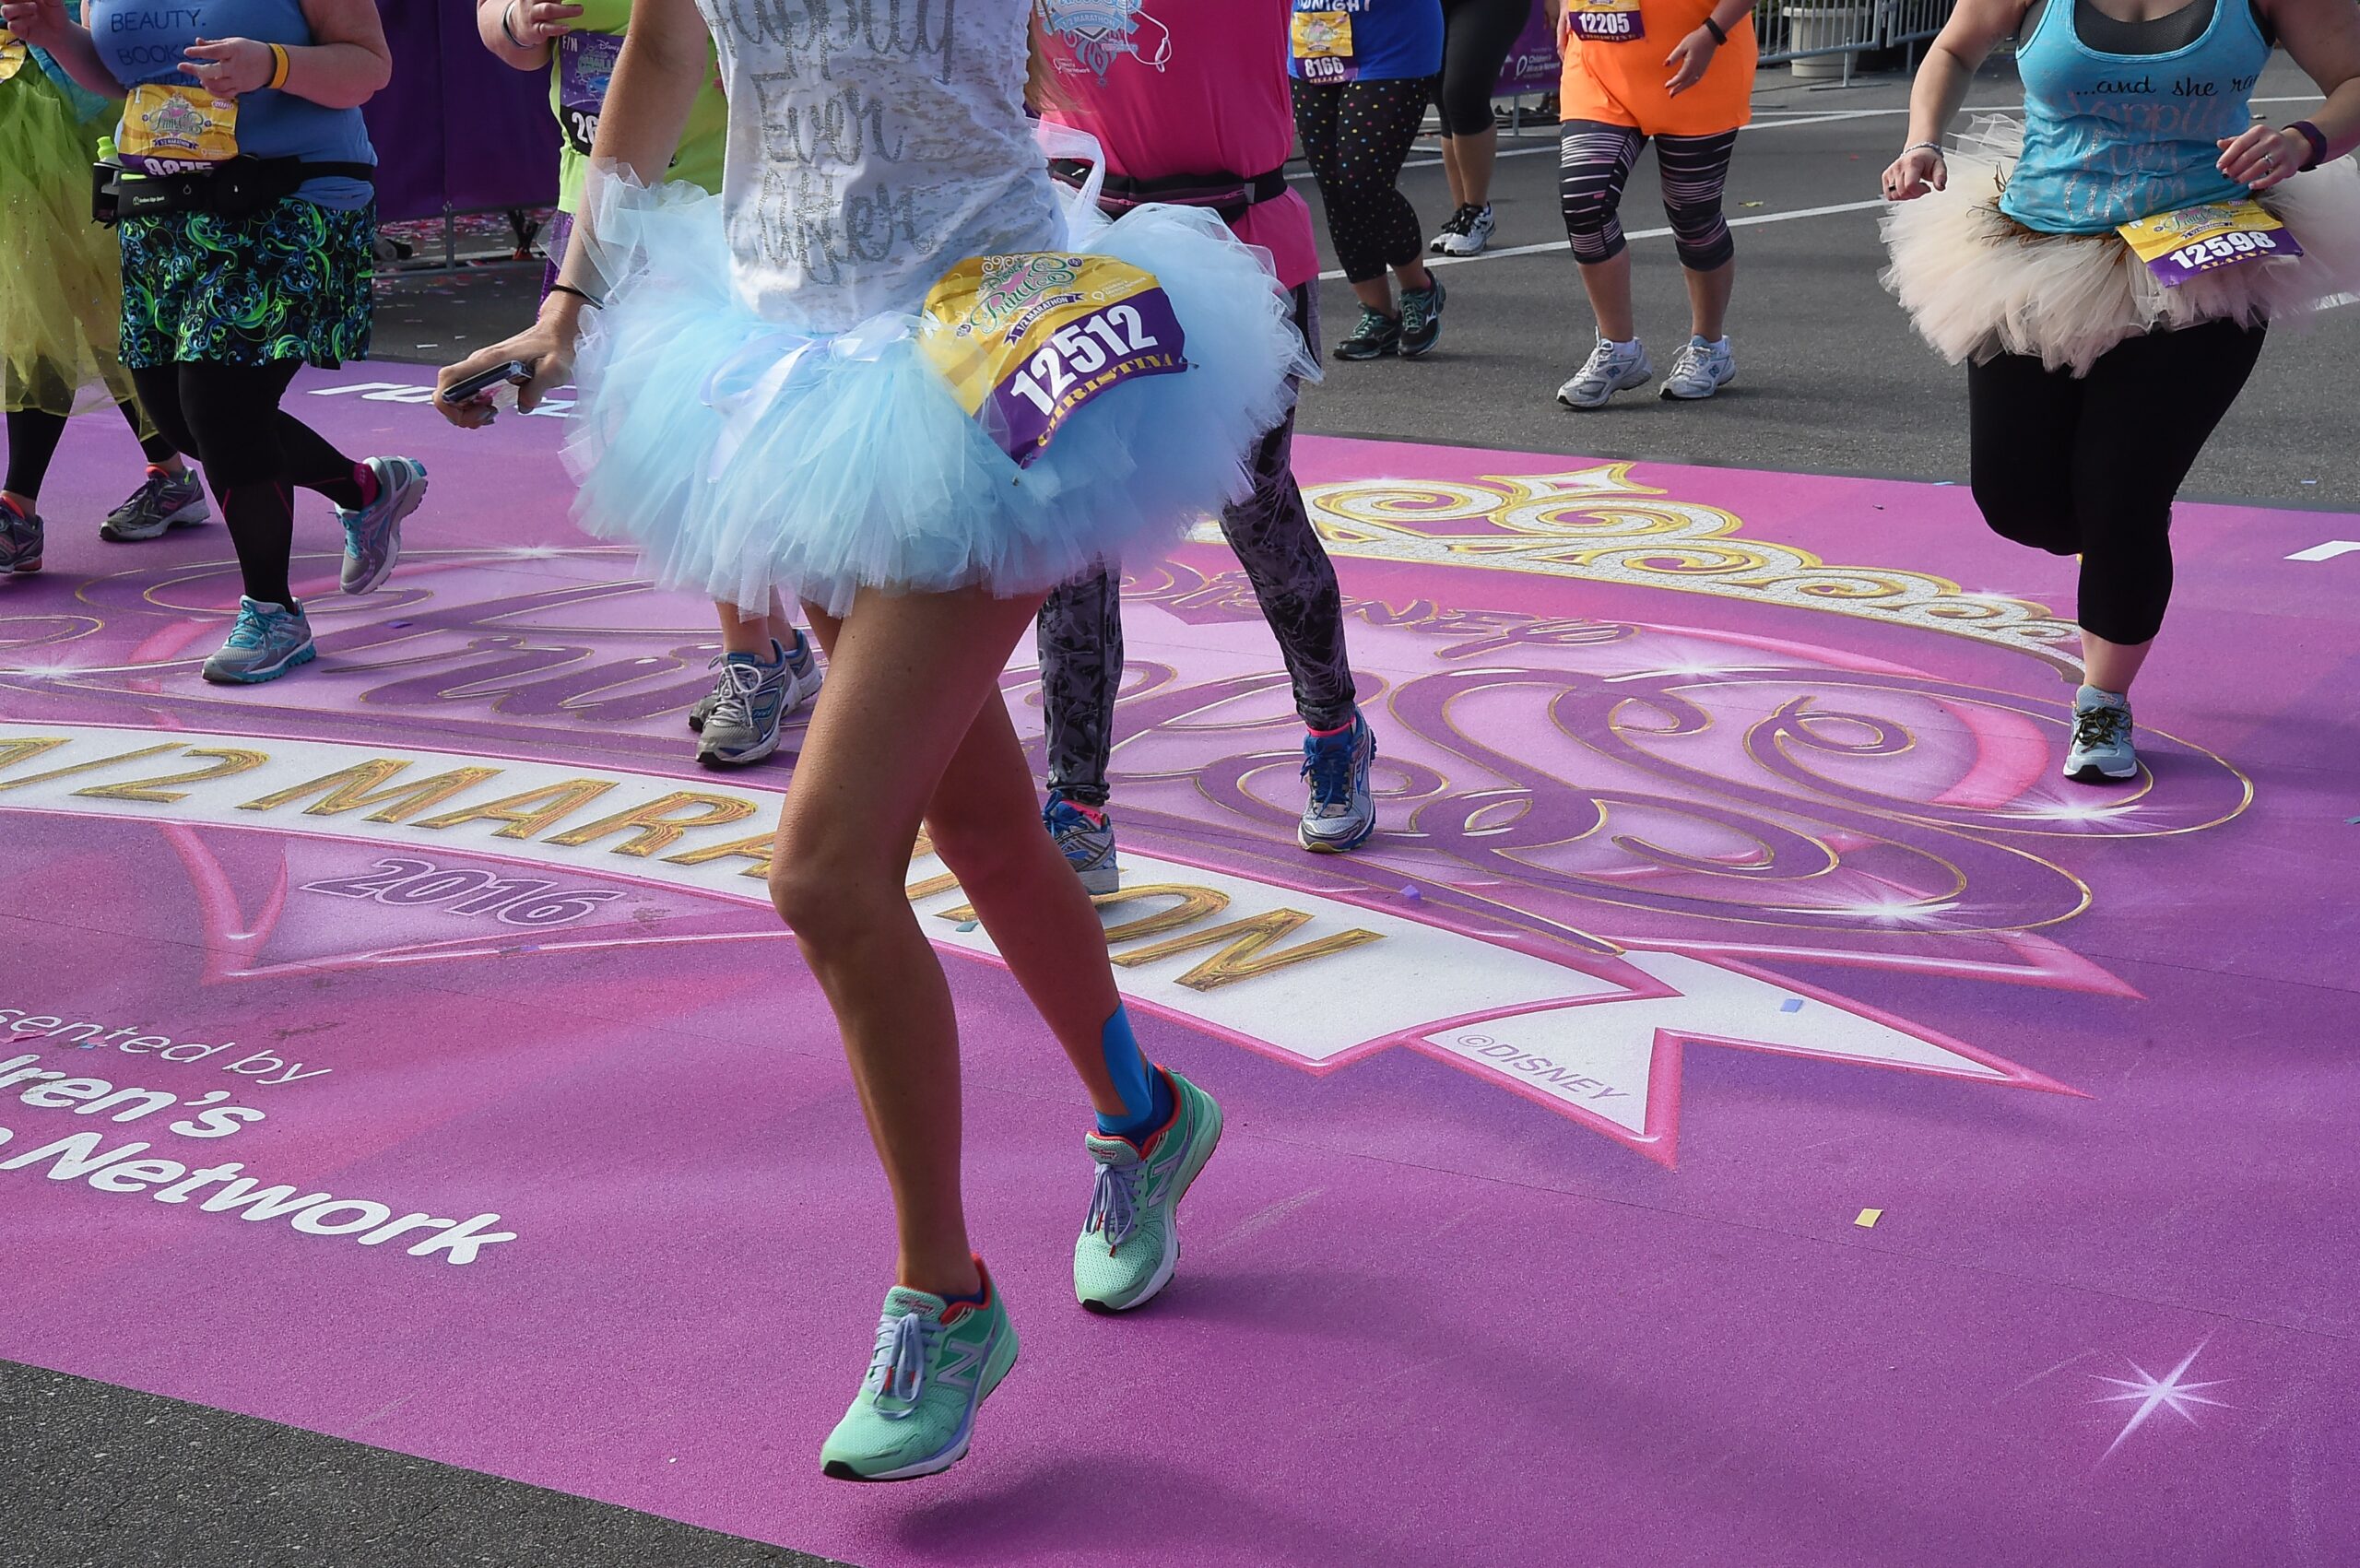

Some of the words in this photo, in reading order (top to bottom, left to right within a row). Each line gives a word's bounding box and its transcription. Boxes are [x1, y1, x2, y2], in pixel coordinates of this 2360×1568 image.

[111, 8, 206, 32] BEAUTY.
[1074, 14, 1115, 28] MARATHON
[1578, 12, 1630, 34] 12205
[117, 43, 196, 65] BOOK
[1304, 57, 1345, 77] 8166
[2172, 77, 2220, 97] she
[750, 72, 904, 167] Ever
[2169, 231, 2277, 269] 12598
[970, 256, 1078, 335] Princess
[1017, 318, 1029, 332] 1/2
[1026, 296, 1069, 321] MARATHON
[1010, 305, 1158, 417] 12512
[300, 858, 629, 925] 2016
[222, 1049, 333, 1085] by
[0, 1132, 518, 1266] Network
